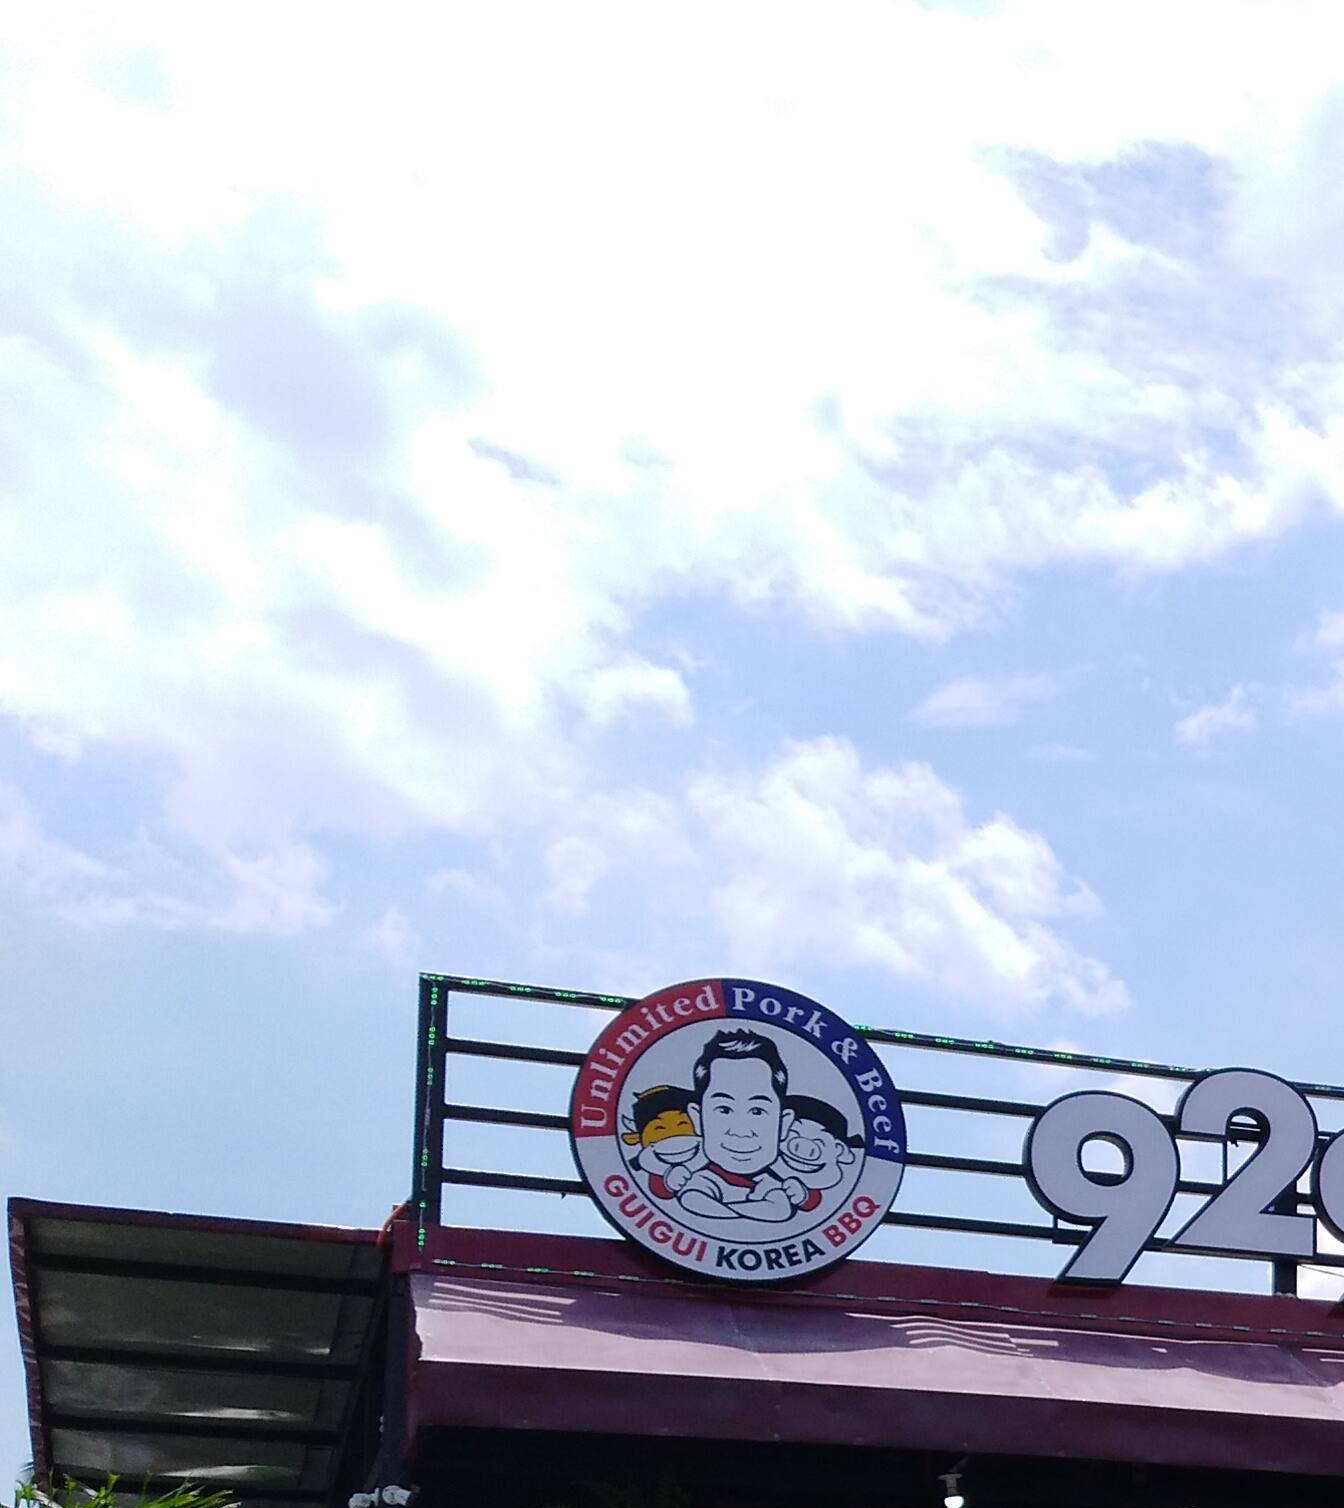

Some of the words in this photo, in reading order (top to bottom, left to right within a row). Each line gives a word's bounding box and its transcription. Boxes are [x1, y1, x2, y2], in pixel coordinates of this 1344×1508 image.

[580, 984, 719, 1131] Unlimited
[731, 986, 828, 1039] Pork
[831, 1037, 858, 1065] &
[855, 1070, 900, 1157] Beef
[603, 1174, 707, 1262] GUIGUI
[716, 1239, 826, 1271] KOREA
[822, 1195, 881, 1248] BBQ
